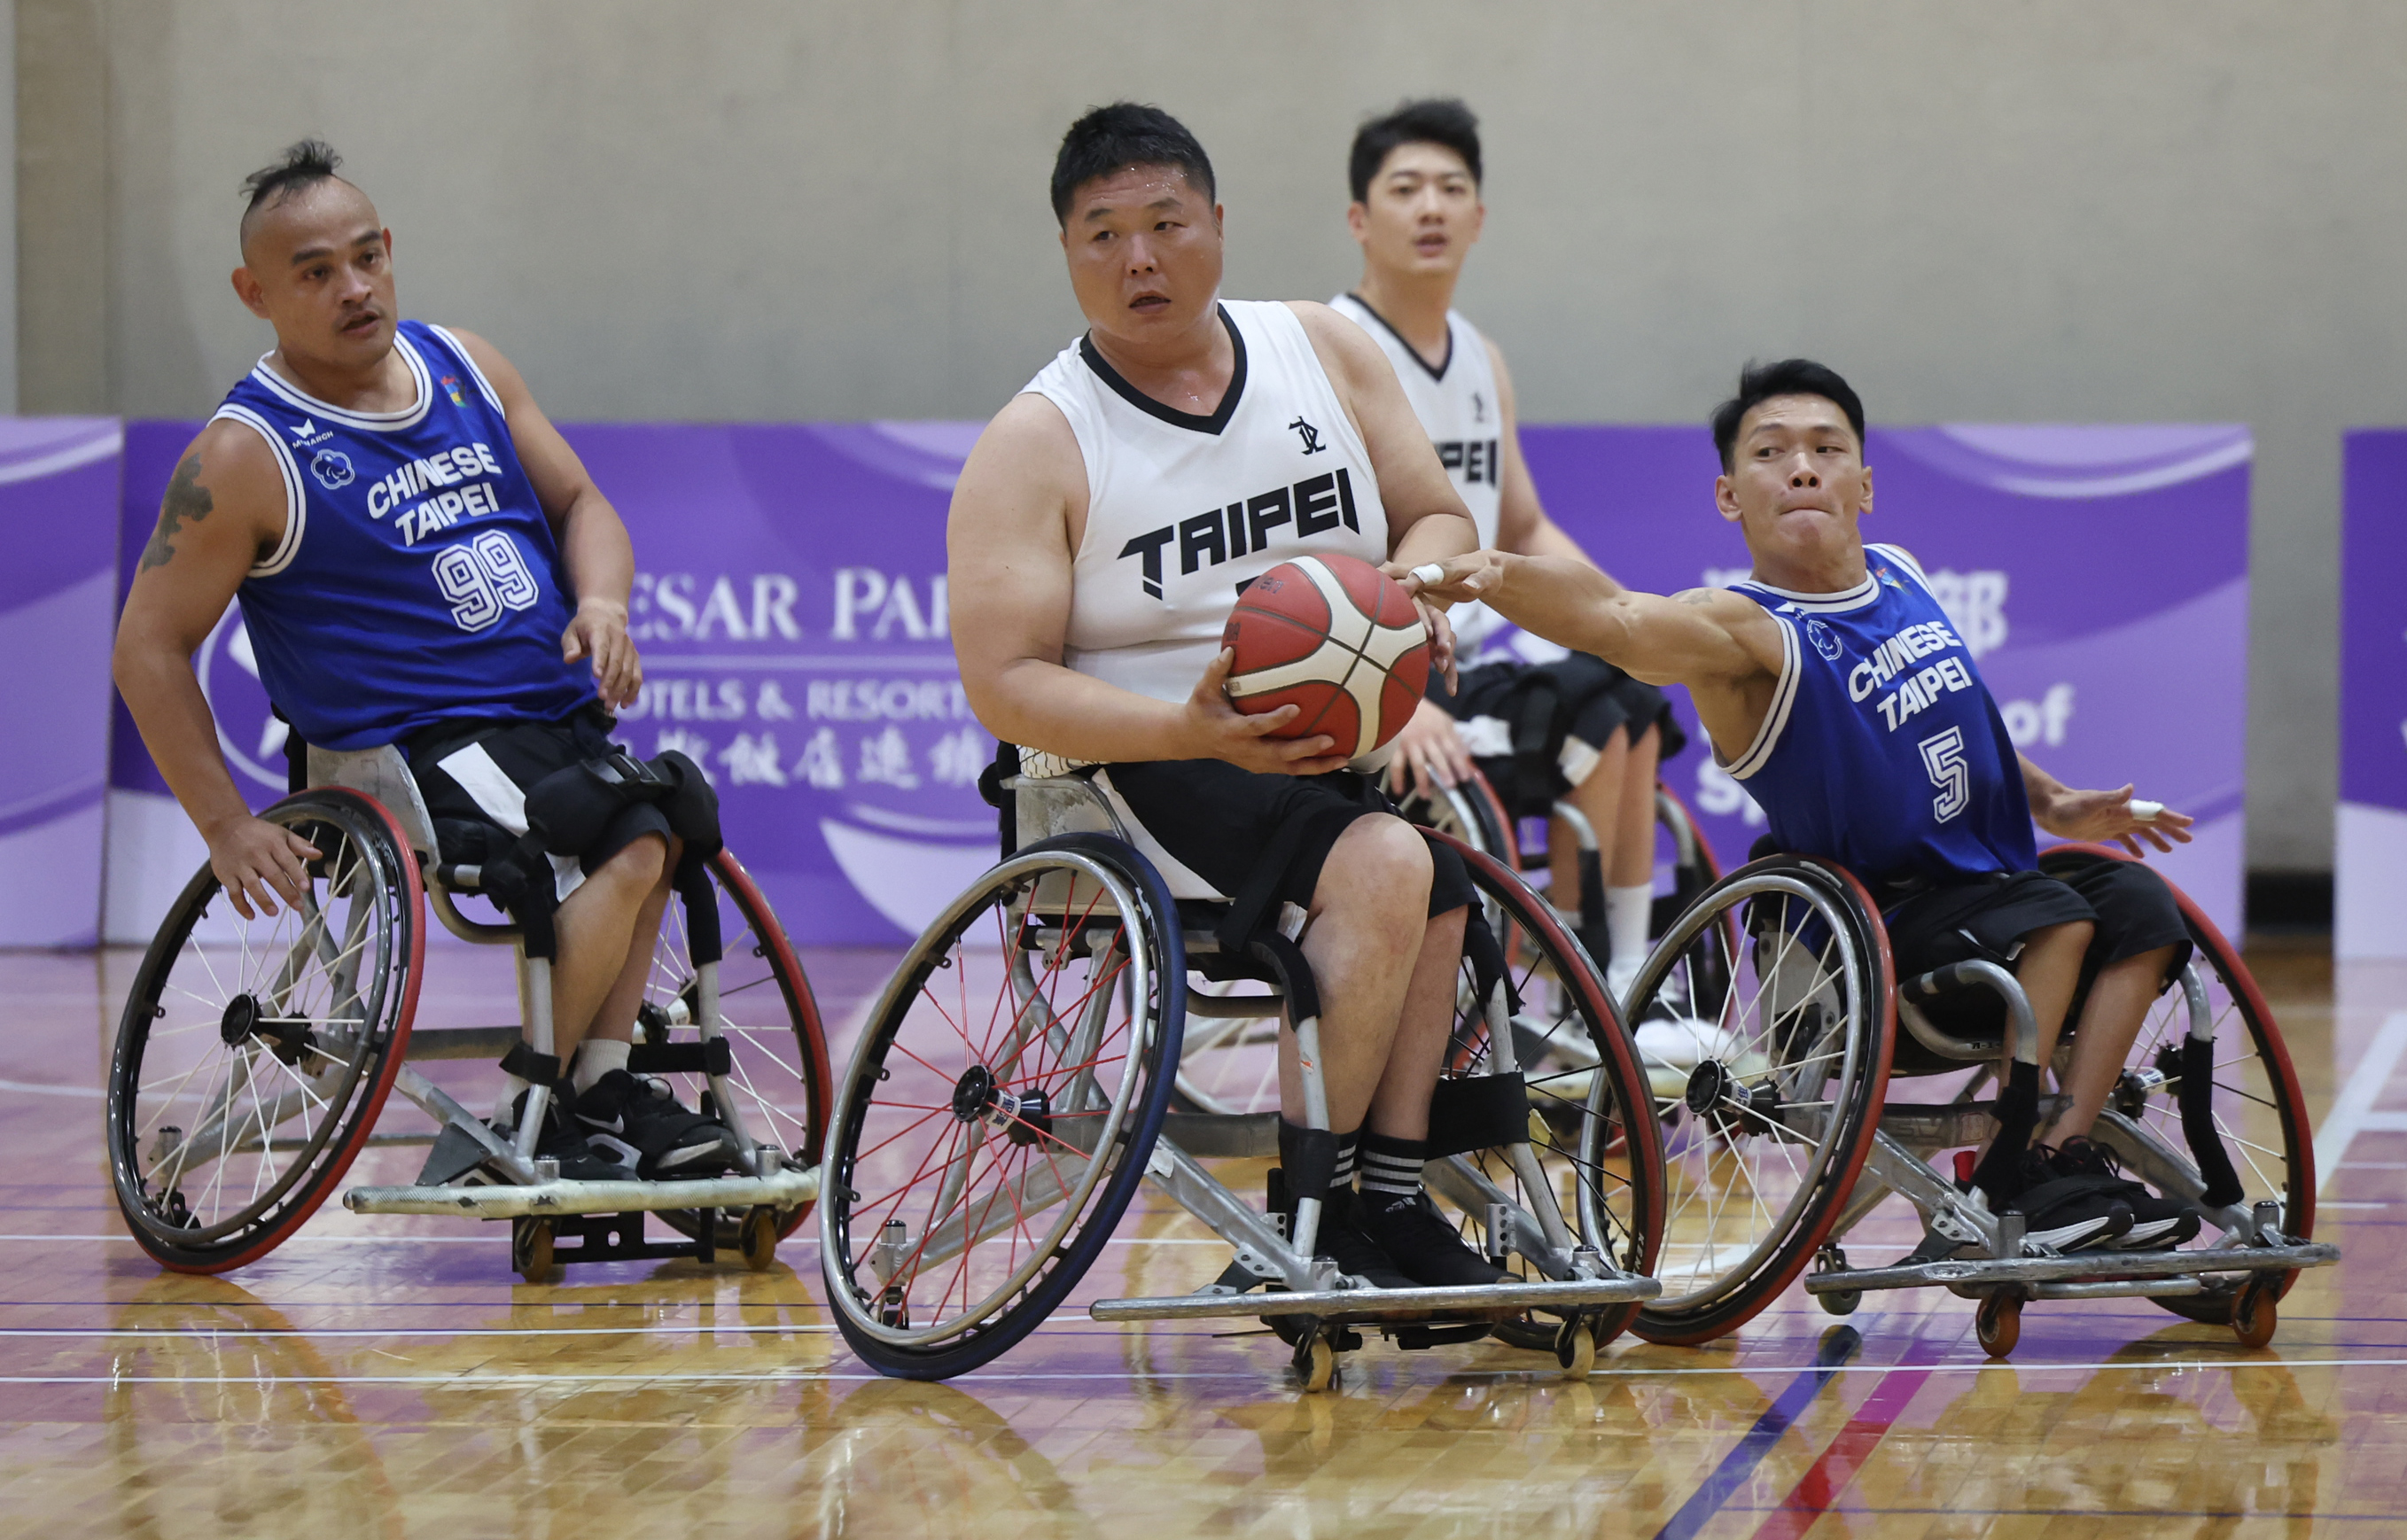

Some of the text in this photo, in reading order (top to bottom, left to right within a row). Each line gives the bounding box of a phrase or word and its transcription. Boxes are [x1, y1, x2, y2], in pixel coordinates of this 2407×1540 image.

[367, 442, 502, 519] CHINESE
[1432, 439, 1498, 491] PEI
[394, 482, 500, 548] TAIPEI
[1117, 467, 1360, 601] TAIPEI
[431, 529, 539, 632] 99
[626, 572, 803, 641] ESAR
[1849, 620, 1962, 703] CHINESE
[1876, 656, 1973, 733] TAIPEI
[615, 679, 747, 721] OTELS
[806, 679, 974, 722] RESORT
[2001, 681, 2076, 747] of
[1917, 725, 1969, 824] 5
